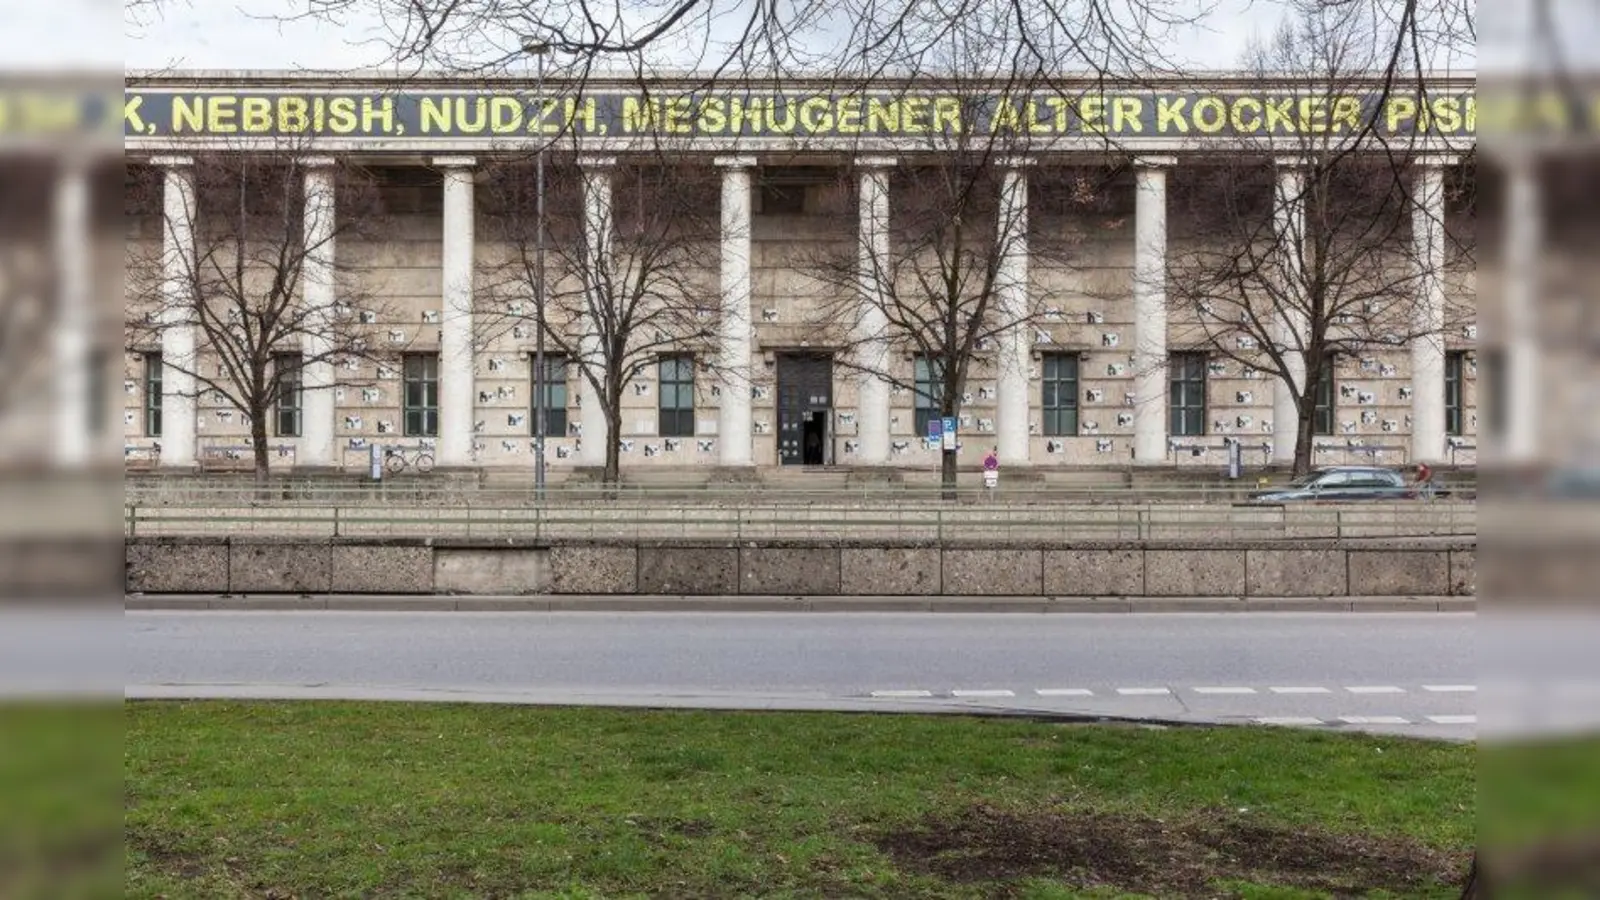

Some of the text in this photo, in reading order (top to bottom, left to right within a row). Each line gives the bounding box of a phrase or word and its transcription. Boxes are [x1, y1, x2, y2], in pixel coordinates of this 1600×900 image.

[172, 95, 405, 136] NEBBISH,
[420, 97, 607, 136] NUDZH,
[990, 96, 1143, 133] ALTER
